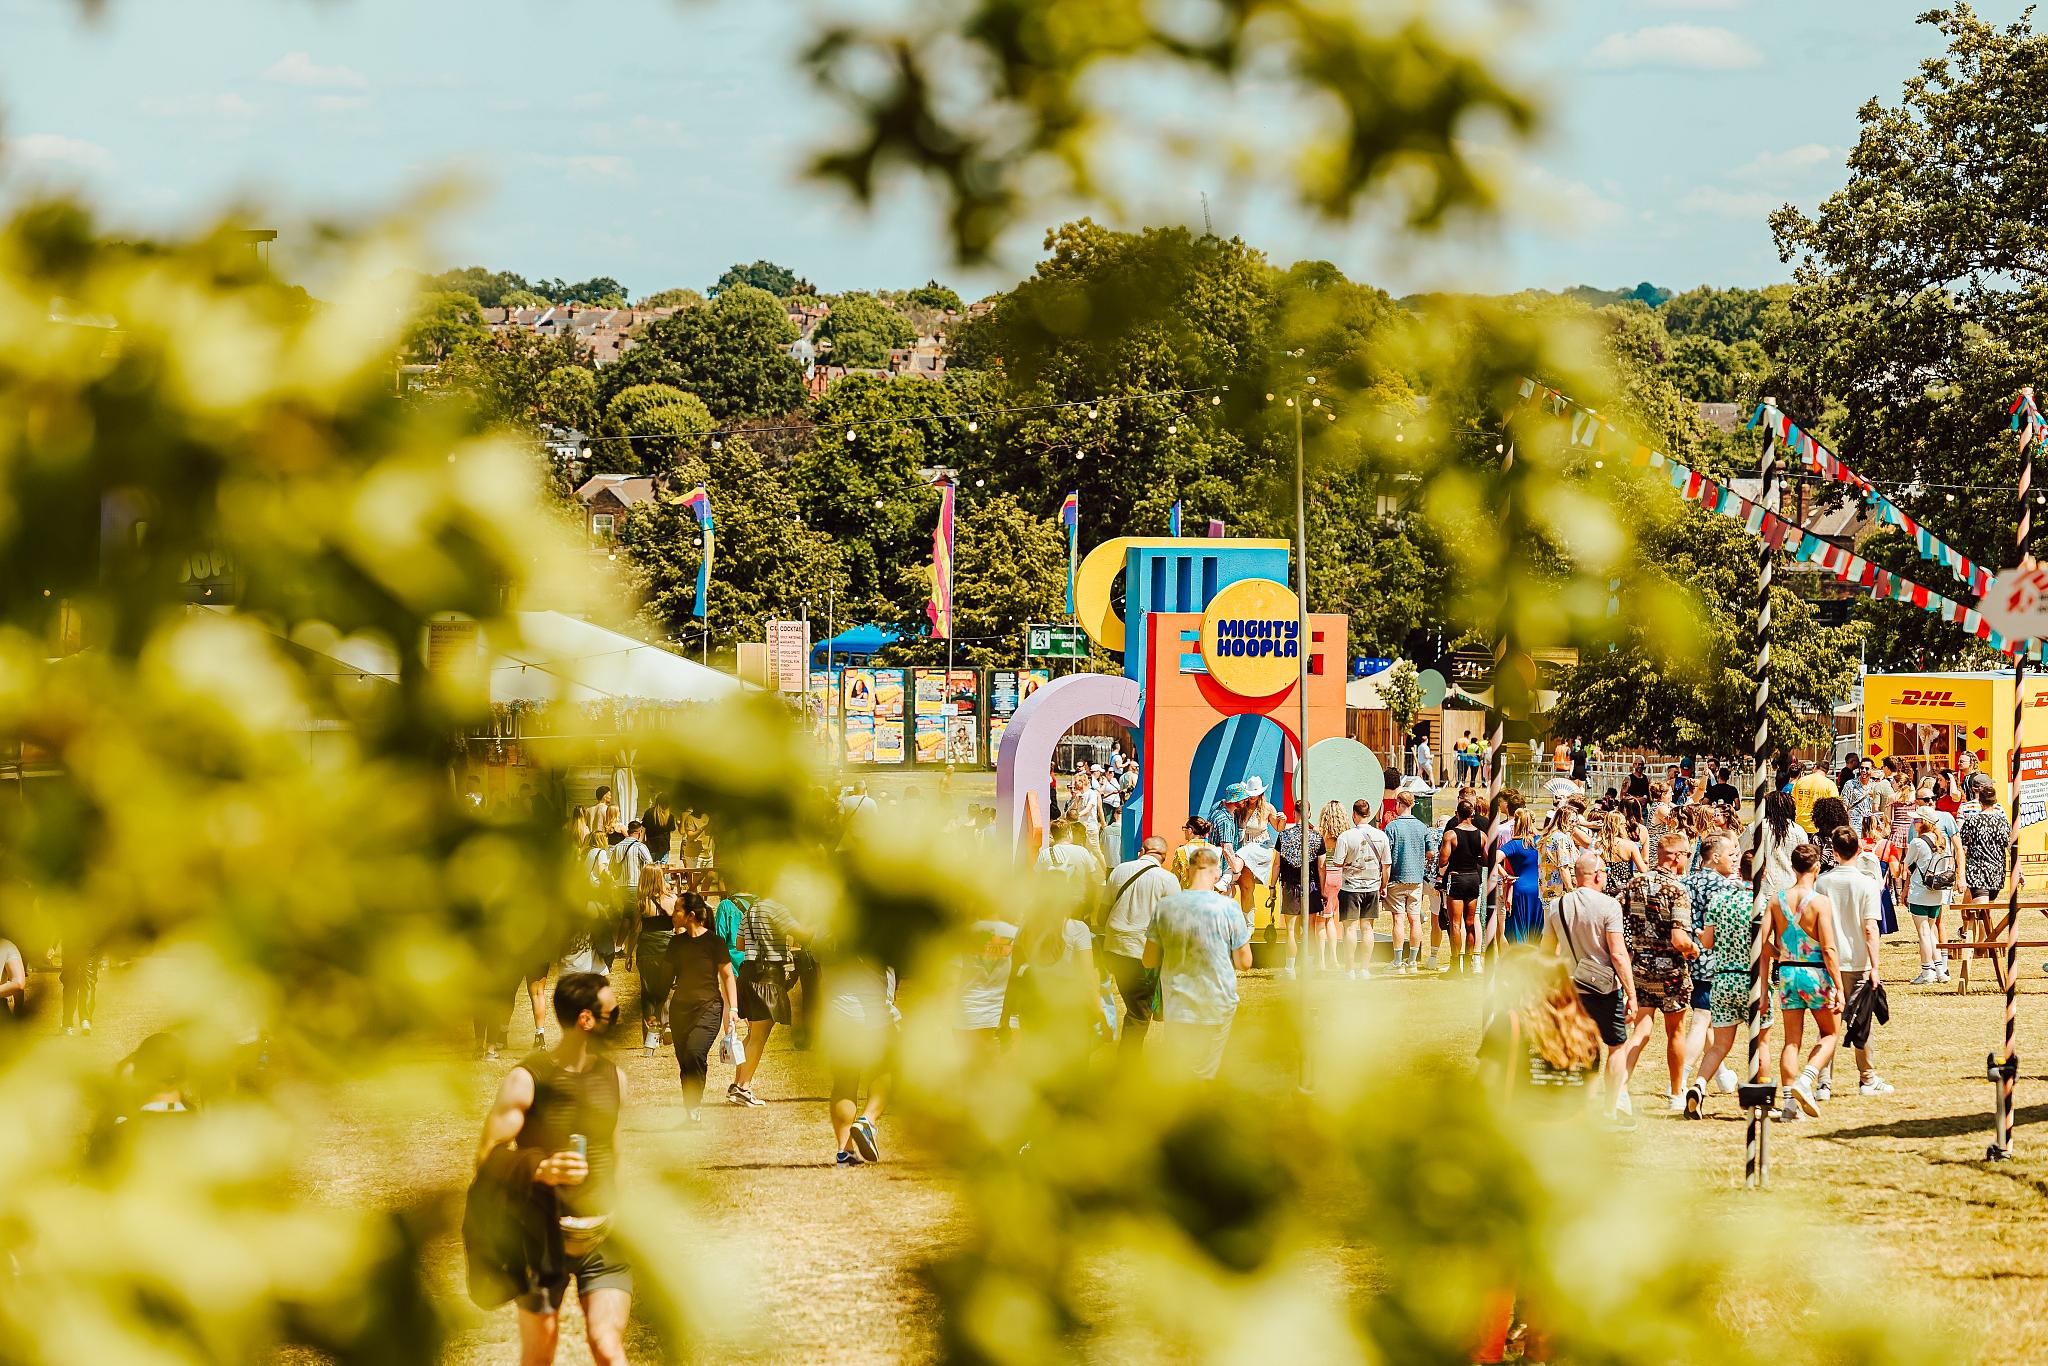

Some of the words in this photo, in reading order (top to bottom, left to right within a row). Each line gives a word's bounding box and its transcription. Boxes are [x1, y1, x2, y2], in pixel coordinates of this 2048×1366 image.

[1218, 619, 1299, 639] MIGHTY
[1217, 638, 1298, 658] HOOPLA
[1901, 690, 1955, 707] DHL
[2020, 801, 2046, 815] MIGHTY
